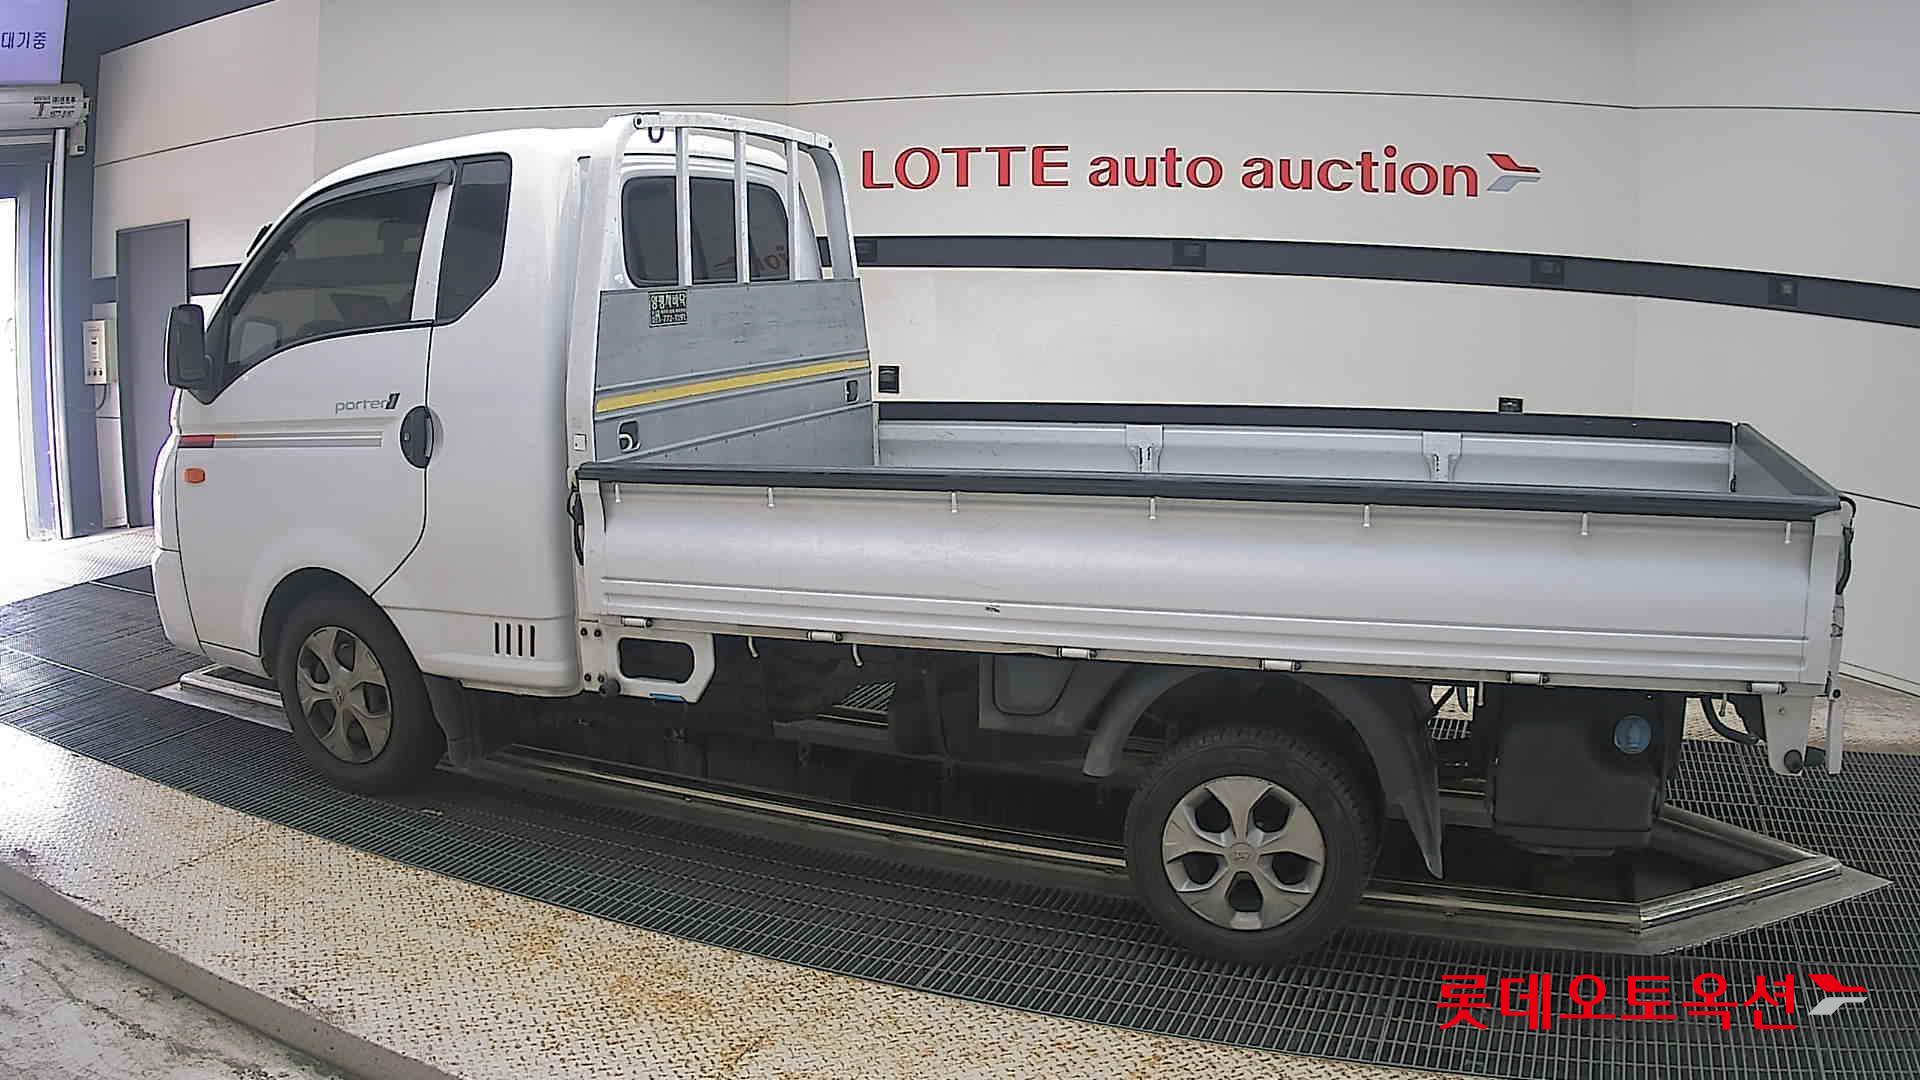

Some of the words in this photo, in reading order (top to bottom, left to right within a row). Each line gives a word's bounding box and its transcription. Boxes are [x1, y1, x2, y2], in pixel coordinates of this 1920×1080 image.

[862, 146, 1069, 189] LOTTE
[1088, 147, 1223, 188] auto
[1241, 145, 1479, 197] auction
